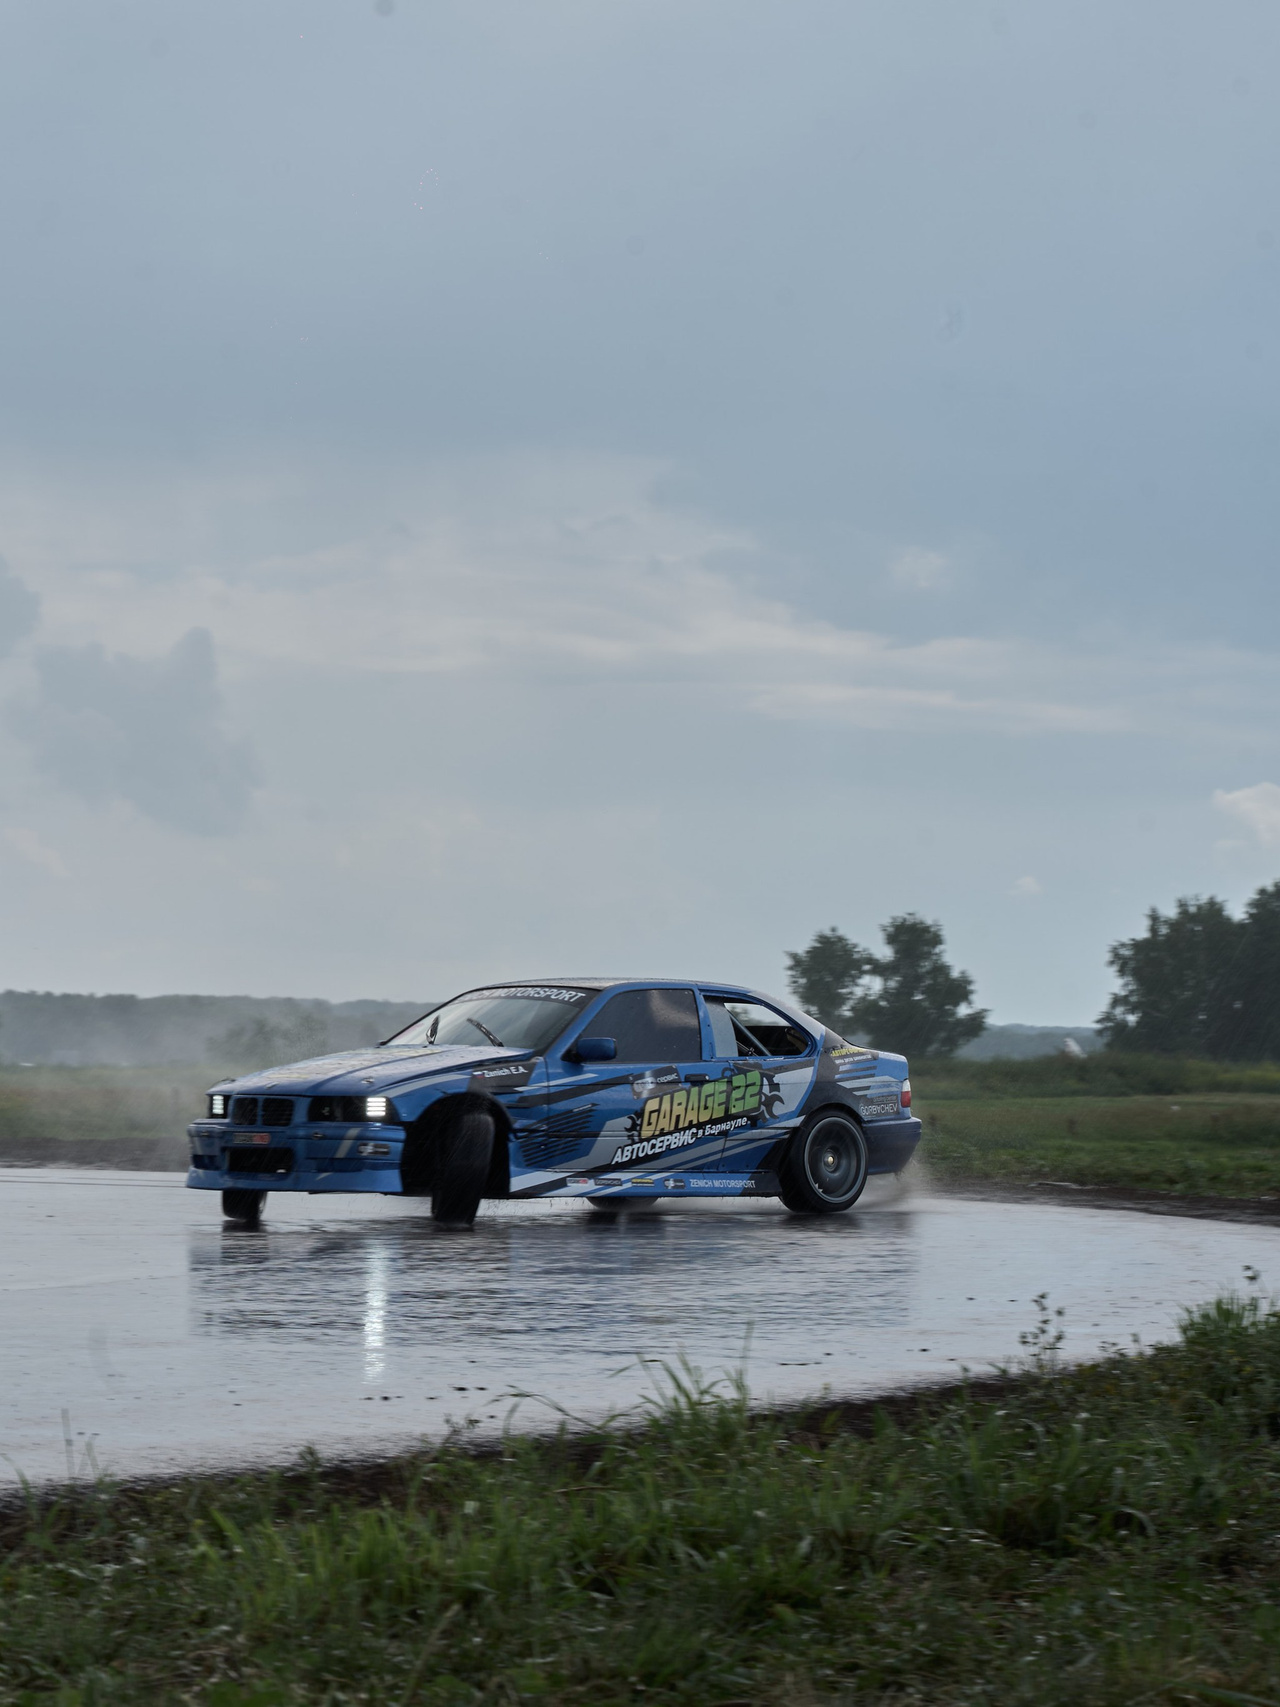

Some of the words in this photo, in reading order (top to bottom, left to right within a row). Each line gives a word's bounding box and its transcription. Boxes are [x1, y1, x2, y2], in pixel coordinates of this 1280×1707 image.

[640, 1079, 728, 1139] GARAGE
[728, 1070, 762, 1115] 22
[611, 1128, 698, 1165] АВТОСЕРВИС
[697, 1130, 703, 1138] в
[690, 1179, 712, 1188] ZENICH
[713, 1179, 756, 1188] MOTORSPORT
